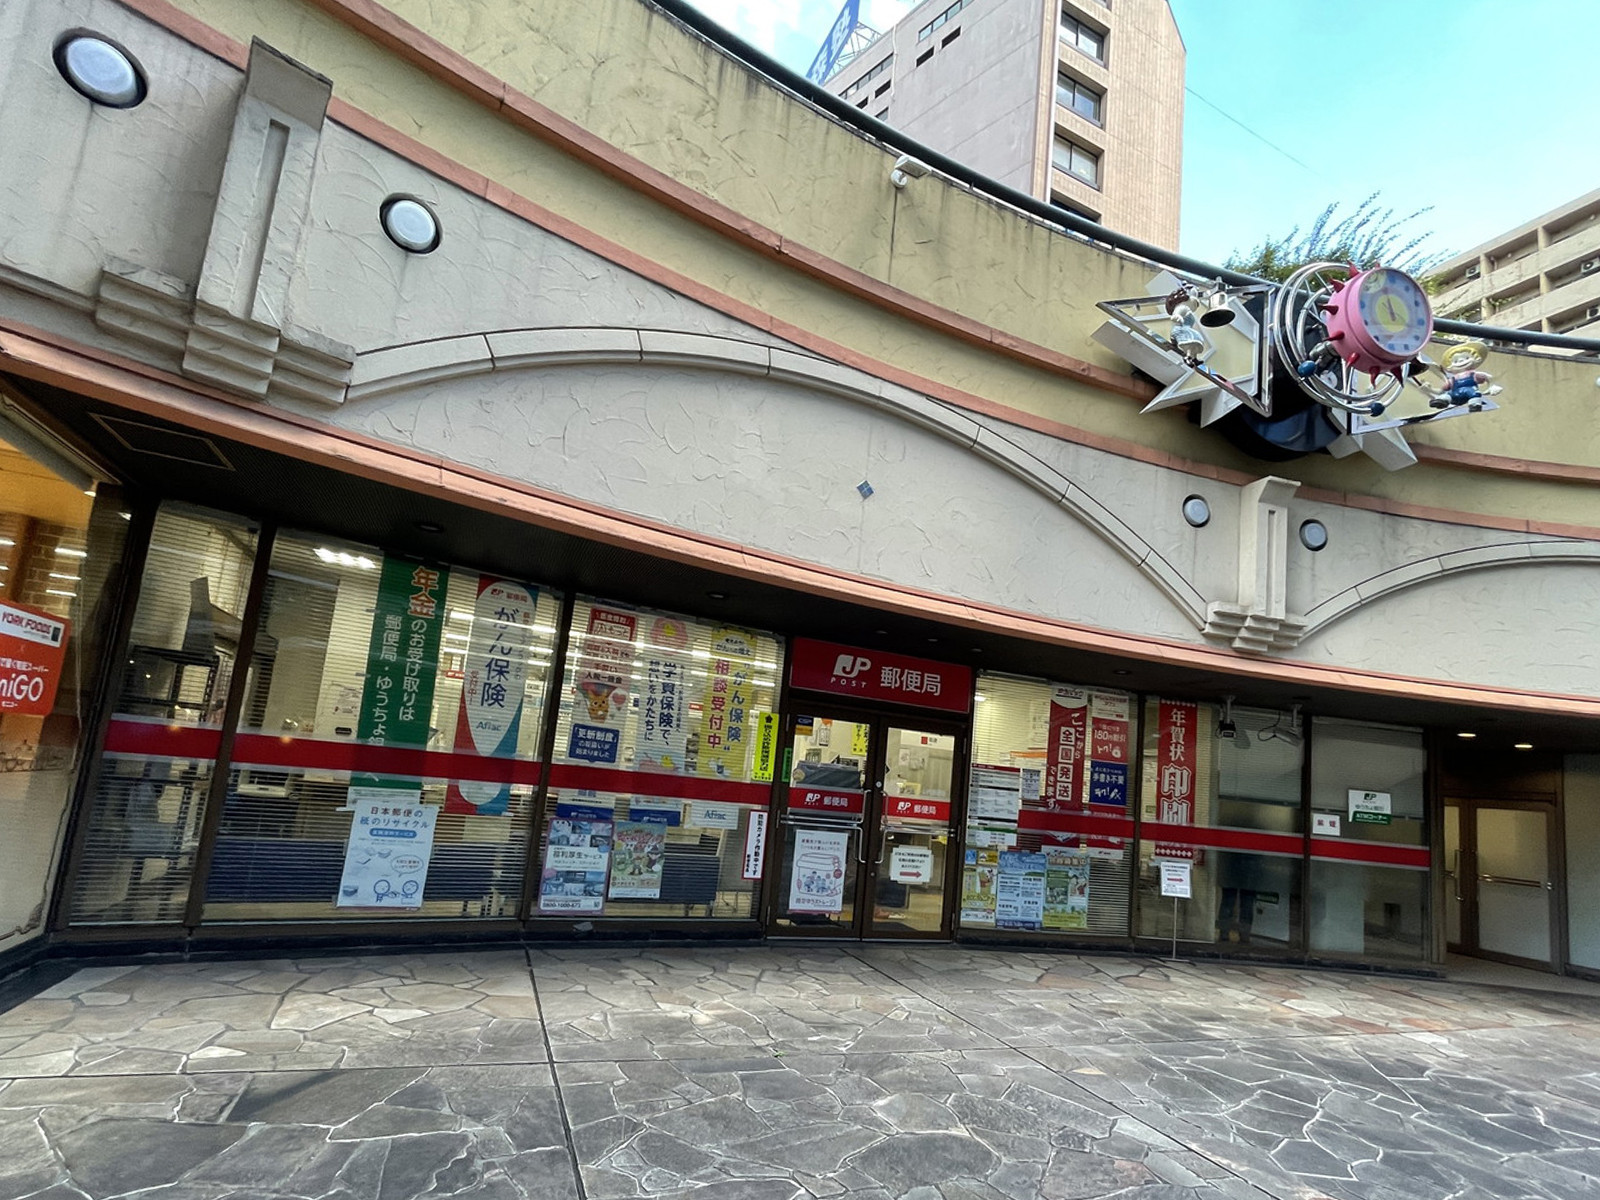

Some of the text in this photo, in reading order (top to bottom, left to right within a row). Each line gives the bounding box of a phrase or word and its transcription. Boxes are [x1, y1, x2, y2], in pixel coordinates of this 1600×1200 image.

[400, 565, 439, 721] 年金のお受け取りは
[481, 606, 520, 709] がん保険
[830, 677, 867, 688] POST
[880, 666, 941, 696] 郵便局
[708, 659, 730, 748] 相談受付中
[1071, 713, 1085, 759] ここから
[1056, 727, 1075, 801] 全国発送
[370, 806, 423, 818] 日本郵便の
[823, 796, 848, 807] 郵便局
[913, 804, 936, 815] 郵便局
